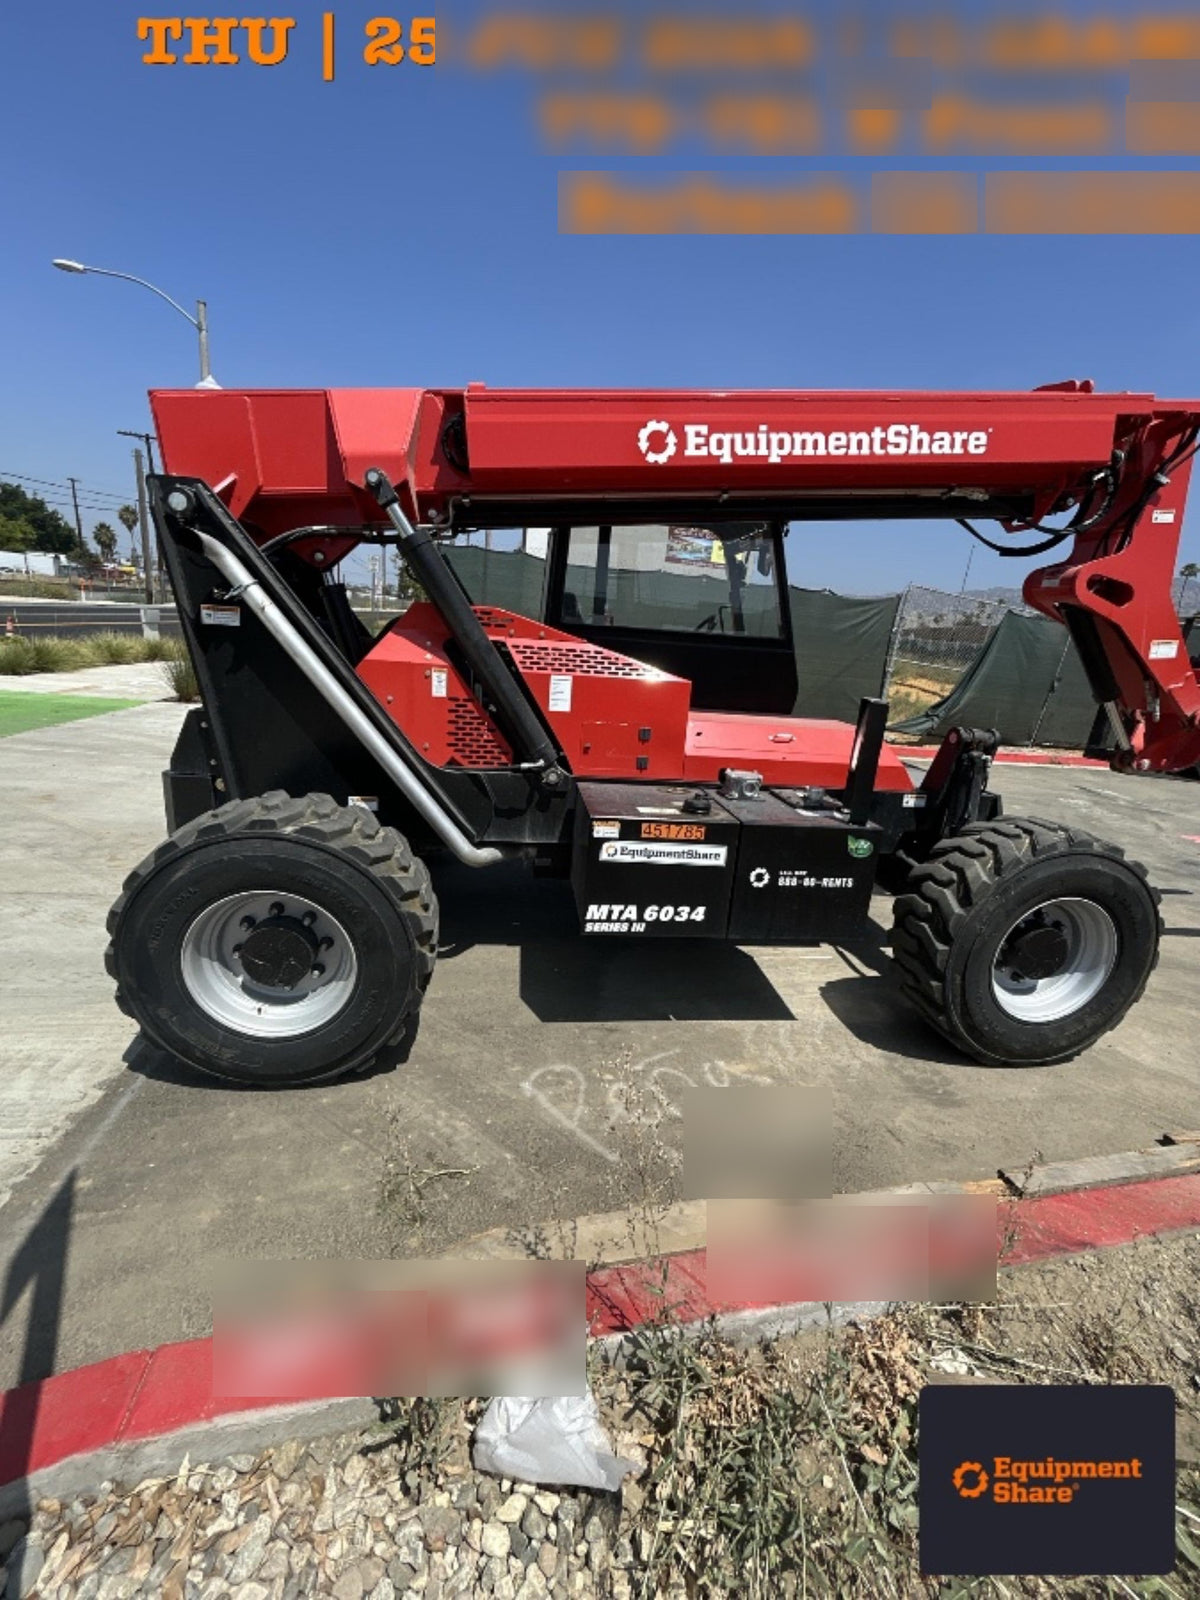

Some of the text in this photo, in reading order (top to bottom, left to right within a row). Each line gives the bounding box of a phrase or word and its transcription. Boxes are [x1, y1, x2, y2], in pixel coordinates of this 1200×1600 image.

[684, 423, 989, 463] EquipmentShare
[642, 824, 705, 840] 451785
[619, 845, 721, 861] EquipmentShare
[585, 904, 707, 922] MTA 6034
[584, 922, 630, 933] SERIES
